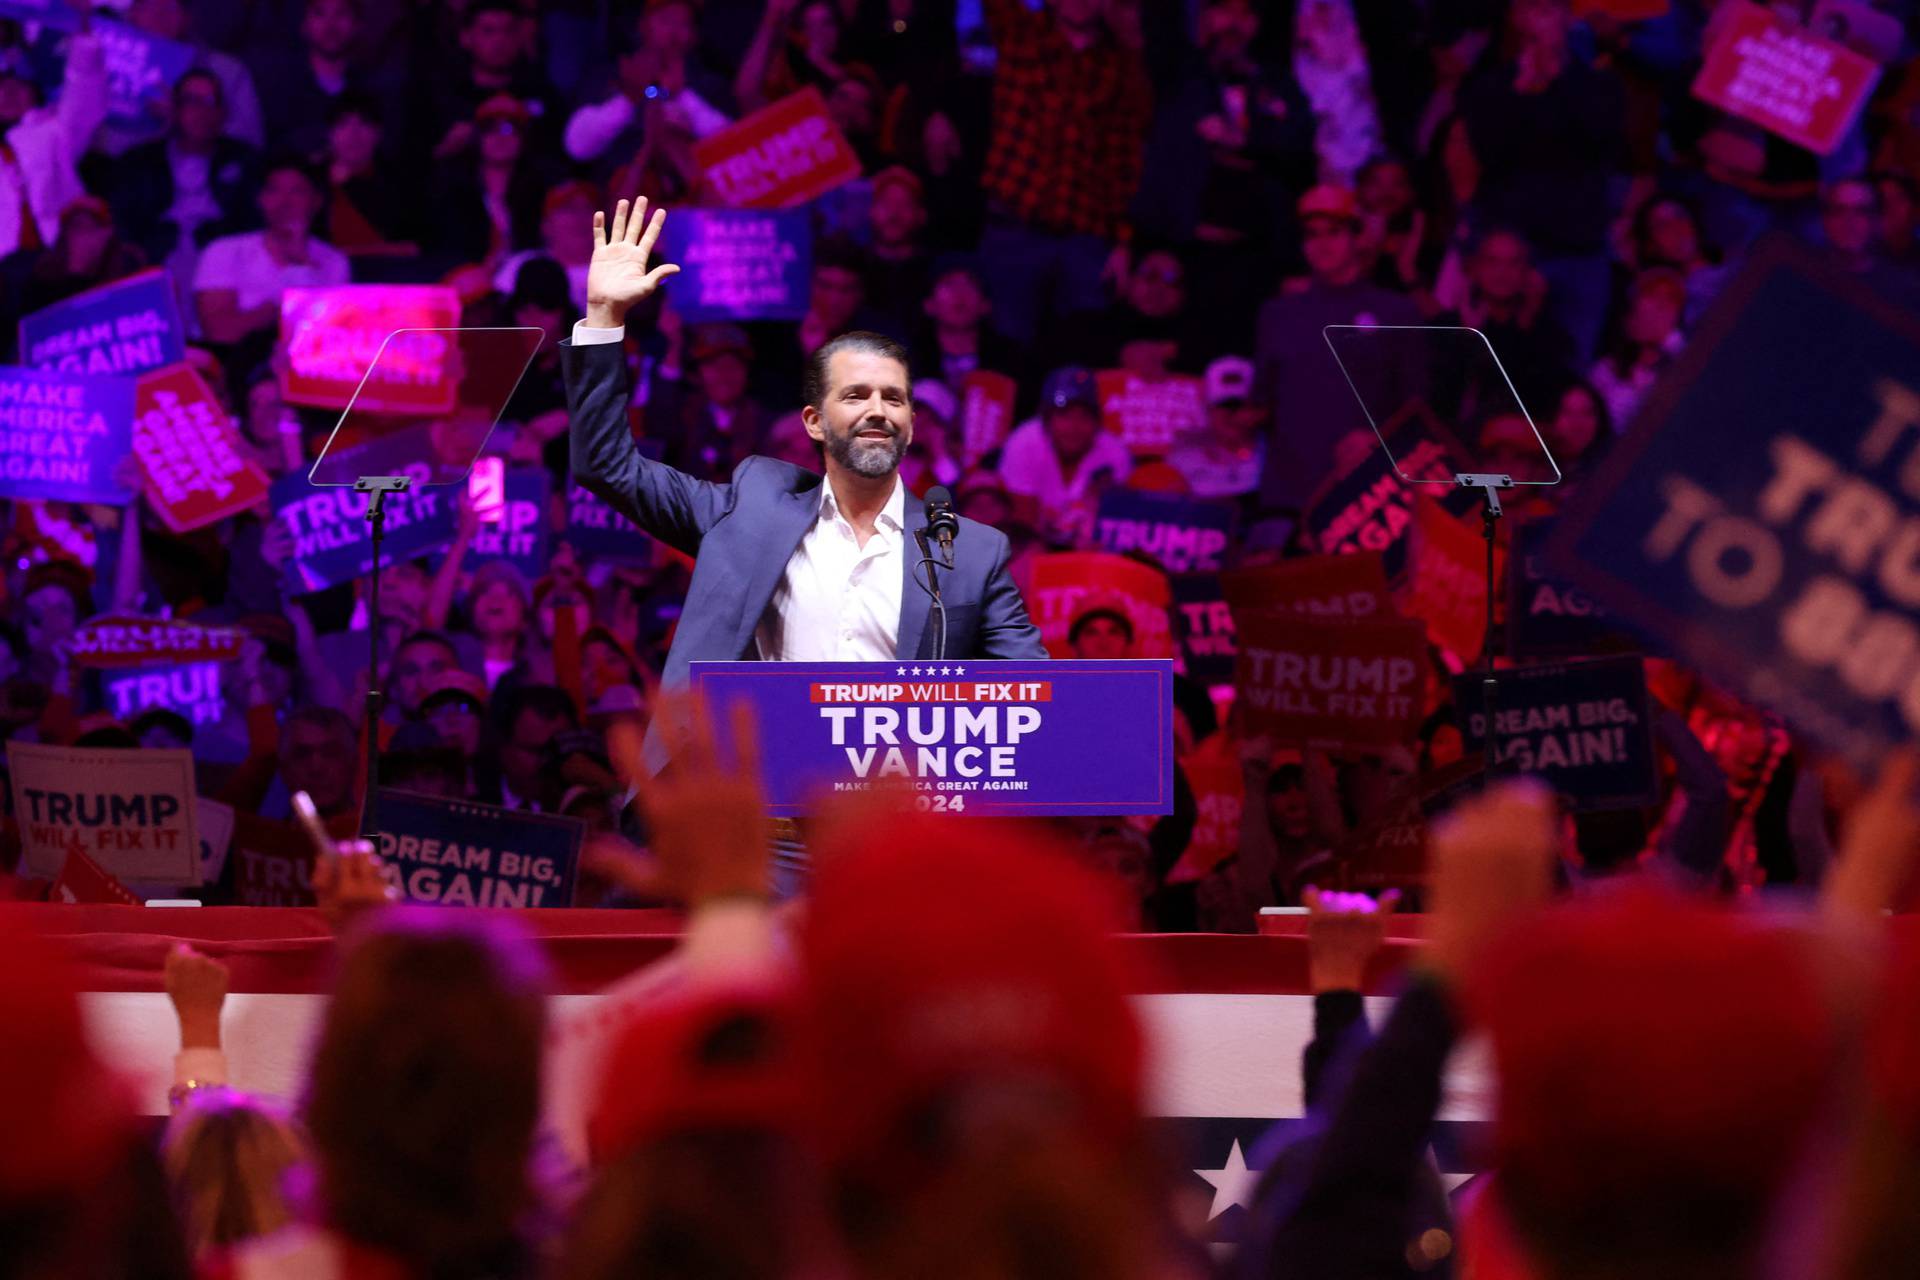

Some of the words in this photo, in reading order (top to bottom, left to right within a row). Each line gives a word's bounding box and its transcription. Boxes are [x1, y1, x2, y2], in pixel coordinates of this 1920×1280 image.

[0, 406, 108, 437] MERICA
[0, 431, 89, 458] REAT
[0, 457, 90, 484] GAIN!
[1245, 647, 1416, 695] TRUMP
[111, 661, 220, 720] TRU
[820, 685, 903, 701] TRUMP
[909, 684, 968, 701] WILL
[975, 683, 1013, 701] FIX
[1019, 683, 1041, 701] IT
[1328, 693, 1376, 718] FIX
[1387, 695, 1412, 720] IT
[1576, 697, 1638, 726] BIG,
[820, 706, 1042, 746] TRUMP
[845, 748, 1016, 780] VANCE
[937, 783, 978, 792] GREAT
[983, 782, 1028, 792] AGAIN!
[24, 787, 180, 827] TRUMP
[914, 796, 965, 814] 024
[31, 826, 89, 851] WILL
[97, 829, 144, 850] FIX
[155, 828, 180, 850] IT
[240, 847, 316, 890] TRU
[379, 832, 491, 873] DREAM
[498, 853, 562, 888] BIG,
